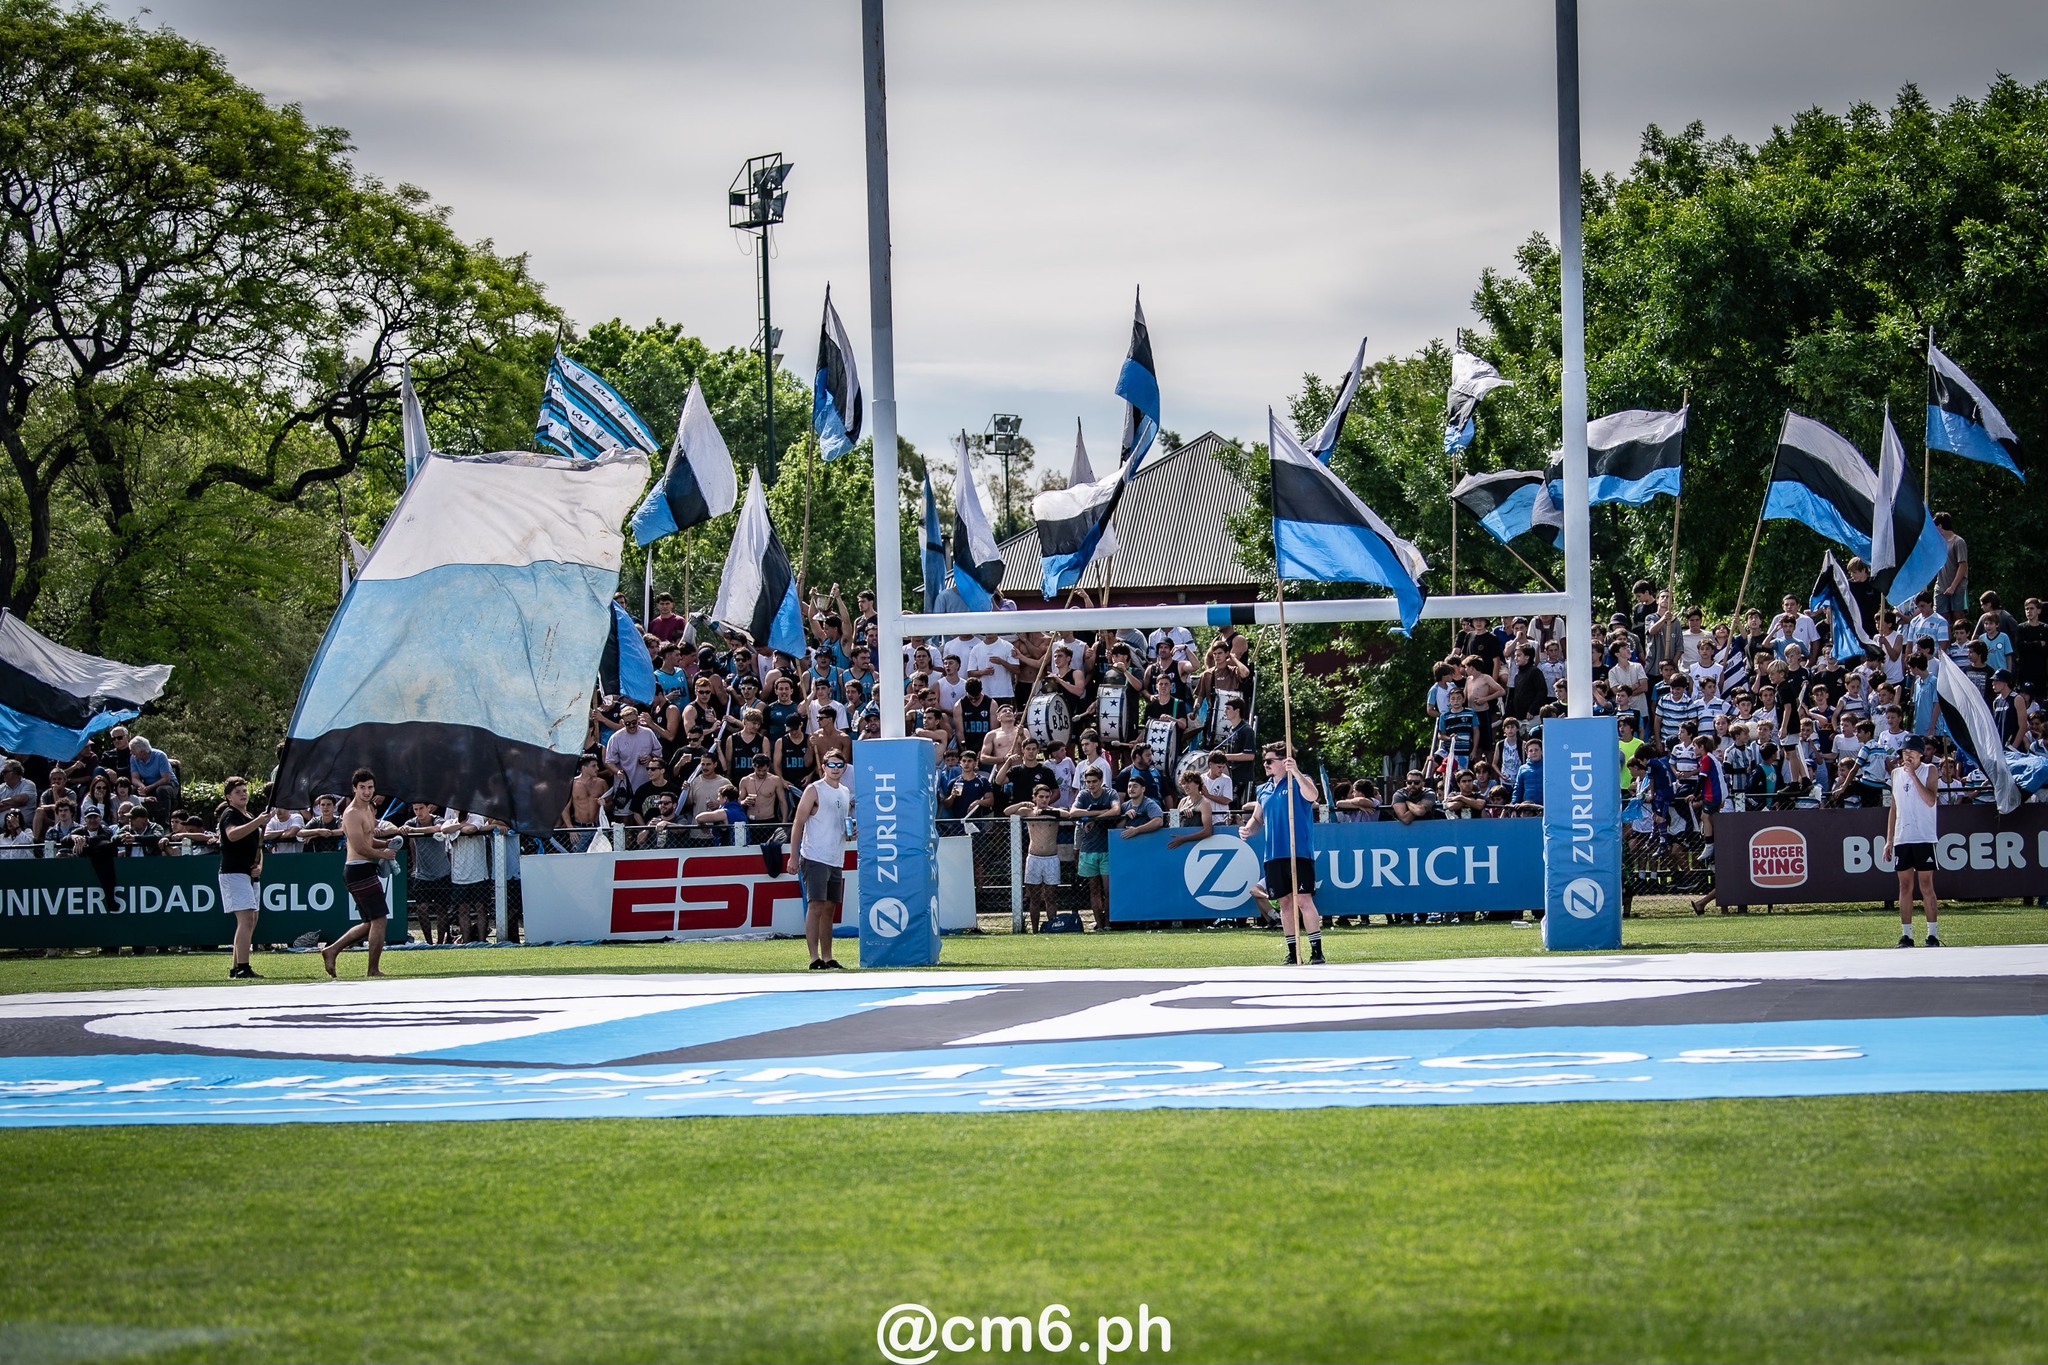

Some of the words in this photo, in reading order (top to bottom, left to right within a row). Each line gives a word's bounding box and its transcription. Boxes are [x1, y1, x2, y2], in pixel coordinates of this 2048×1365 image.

[875, 773, 898, 884] ZURICH
[1571, 751, 1594, 864] ZURICH
[1752, 846, 1804, 858] BURGER
[1753, 858, 1805, 875] KING
[1843, 831, 2027, 873] BUGER
[0, 885, 215, 916] NIVERSIDAD
[262, 882, 335, 912] GLO
[611, 850, 858, 933] ESP
